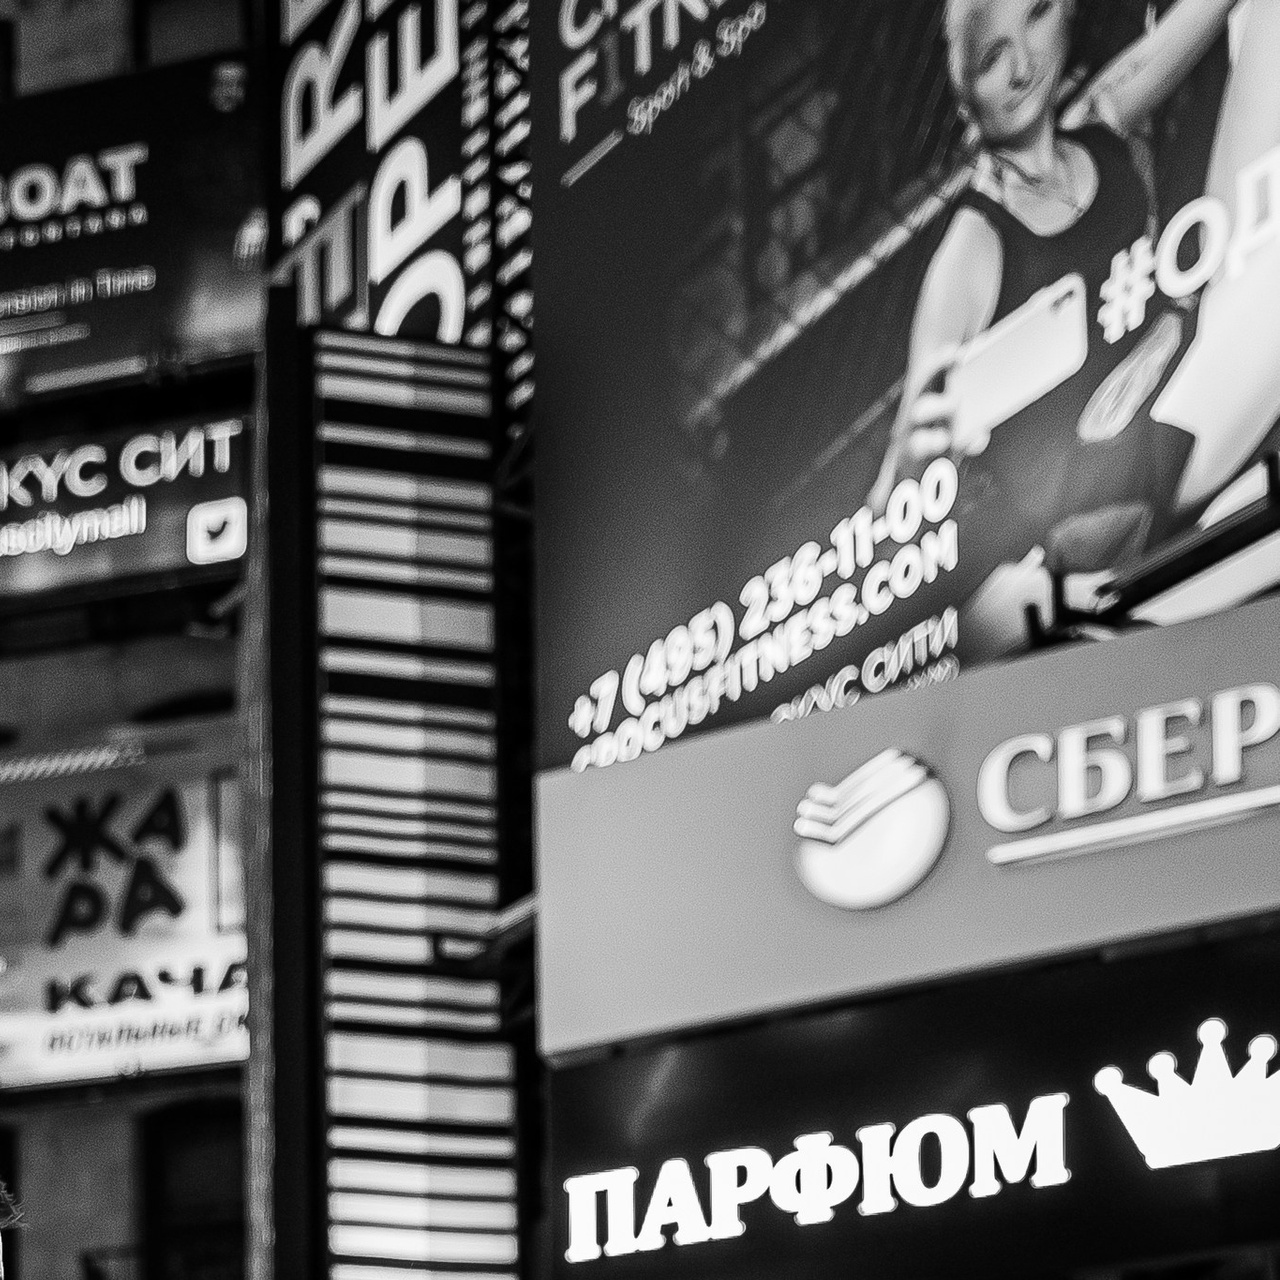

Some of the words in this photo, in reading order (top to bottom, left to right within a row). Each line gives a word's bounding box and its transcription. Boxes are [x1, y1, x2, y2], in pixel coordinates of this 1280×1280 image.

[568, 669, 620, 738] +7
[622, 601, 735, 717] (495)
[739, 457, 959, 641] 236-11-00
[977, 682, 1280, 833] СБЕР
[564, 1092, 1070, 1262] ПАРФЮМ
